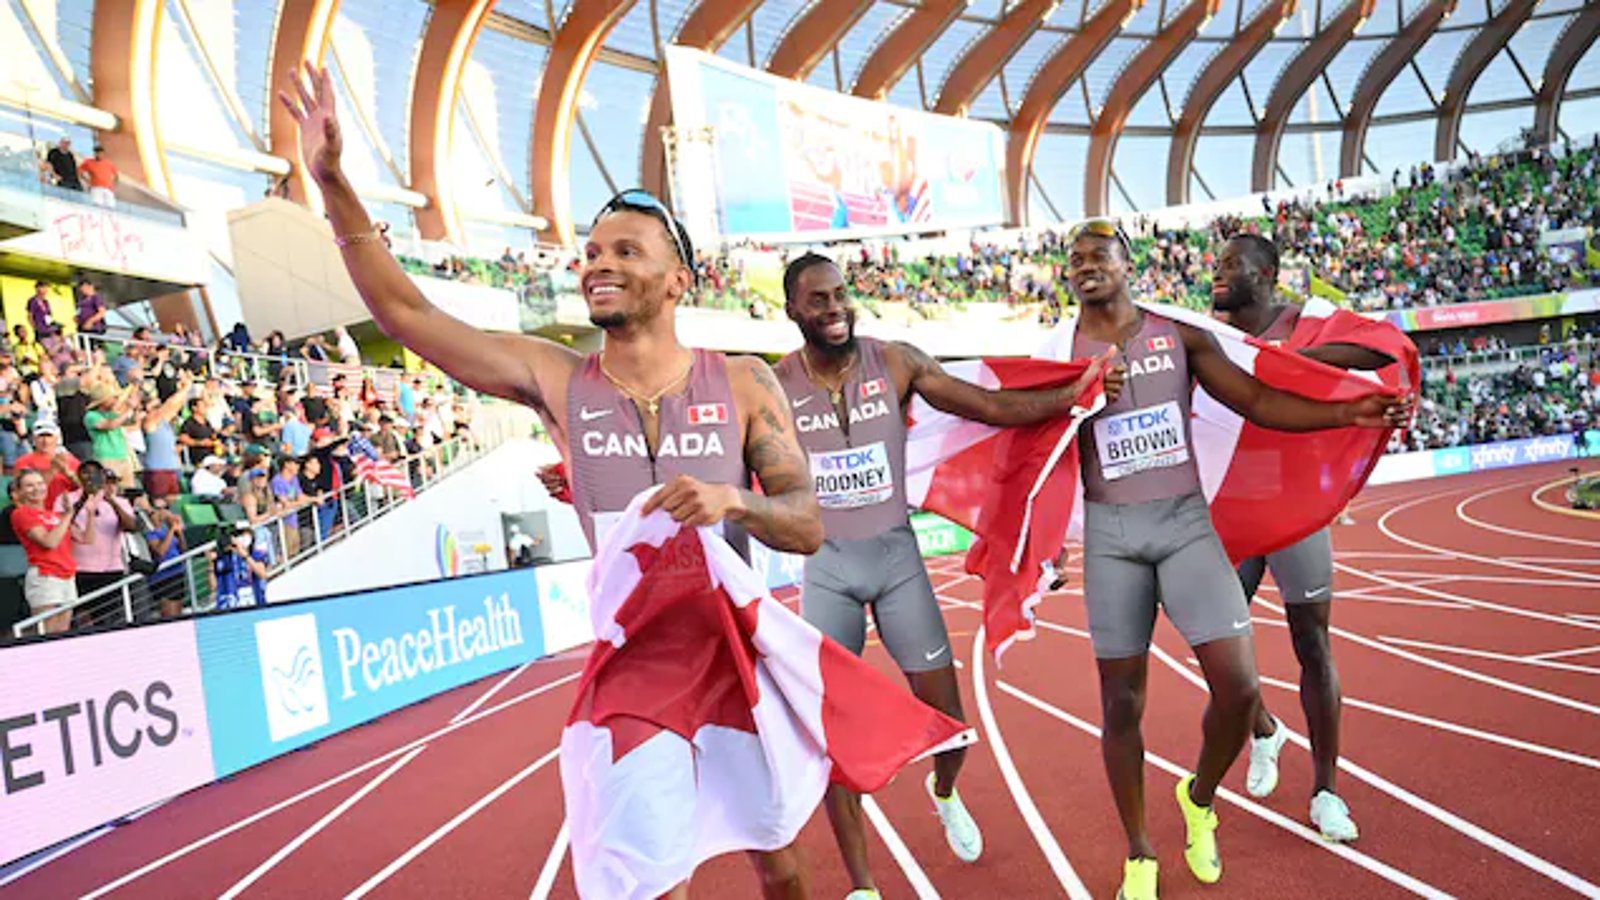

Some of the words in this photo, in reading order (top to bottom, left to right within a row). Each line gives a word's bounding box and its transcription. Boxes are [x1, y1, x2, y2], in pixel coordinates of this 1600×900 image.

[1122, 354, 1176, 379] ADA
[794, 400, 890, 432] CANADA
[1121, 407, 1170, 432] TDK
[582, 430, 725, 458] CANADA
[830, 448, 875, 470] TDK
[1107, 426, 1179, 460] BROWN
[1472, 443, 1517, 470] xfinity
[1524, 436, 1572, 462] xfinity
[332, 591, 525, 700] PeaceHealth
[0, 680, 179, 795] ETICS
